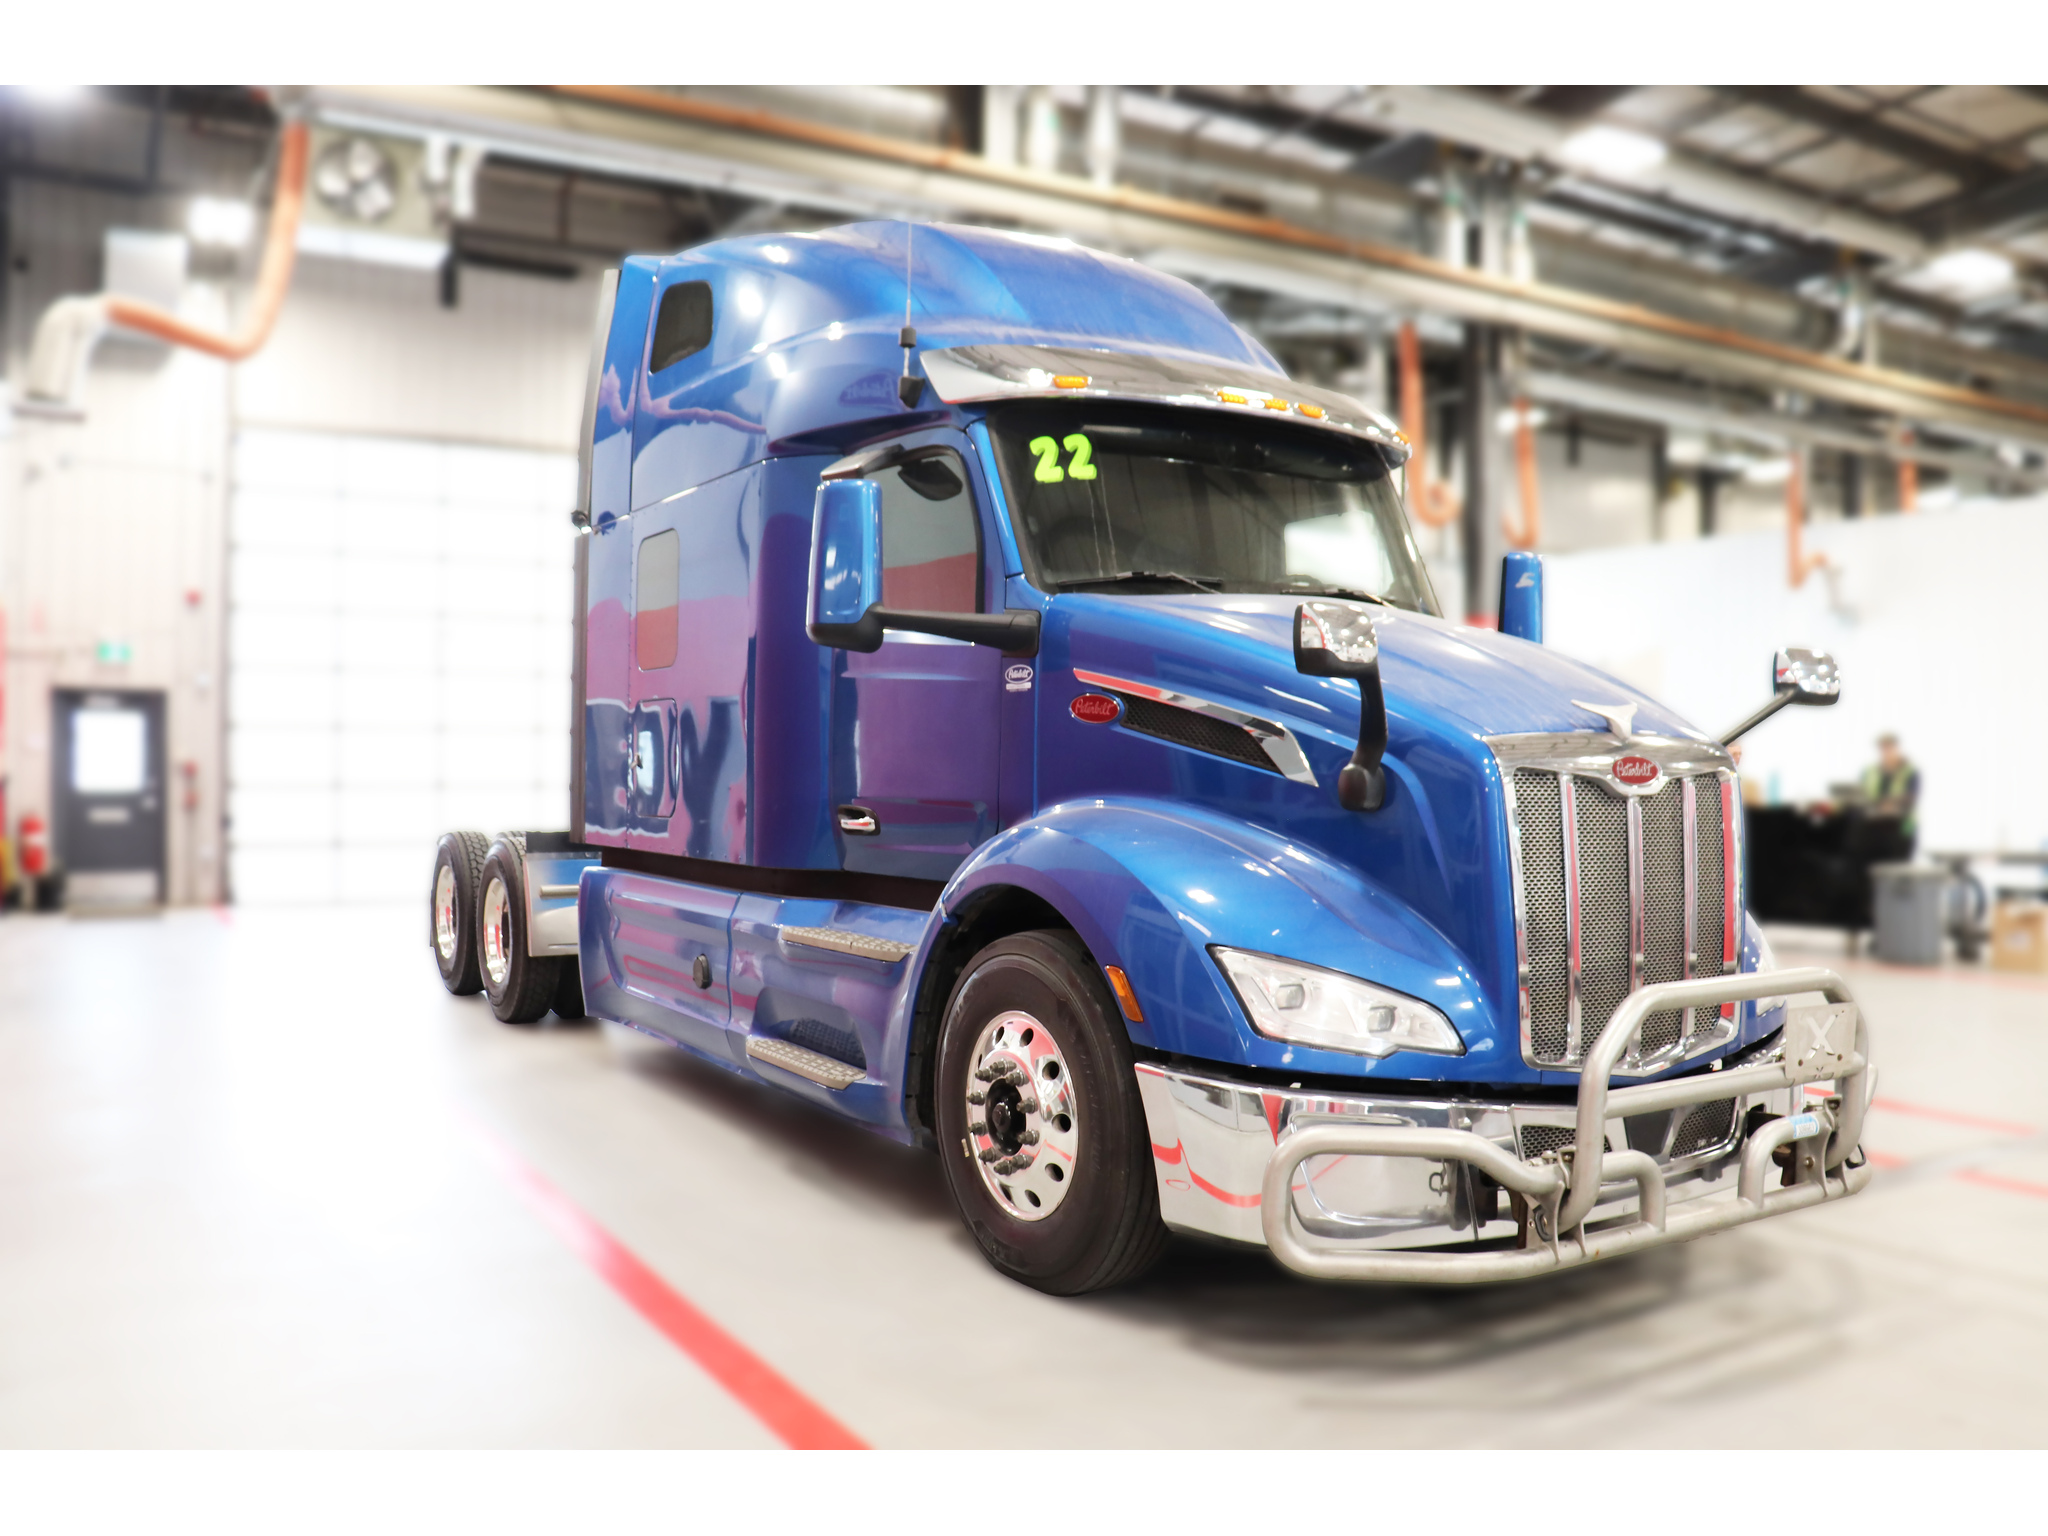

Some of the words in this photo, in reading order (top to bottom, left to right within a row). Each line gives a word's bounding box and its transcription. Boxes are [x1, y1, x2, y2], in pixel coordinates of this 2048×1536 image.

[1029, 433, 1097, 483] 22
[1075, 698, 1114, 715] Peterbilt
[1616, 760, 1655, 777] Peterbilt
